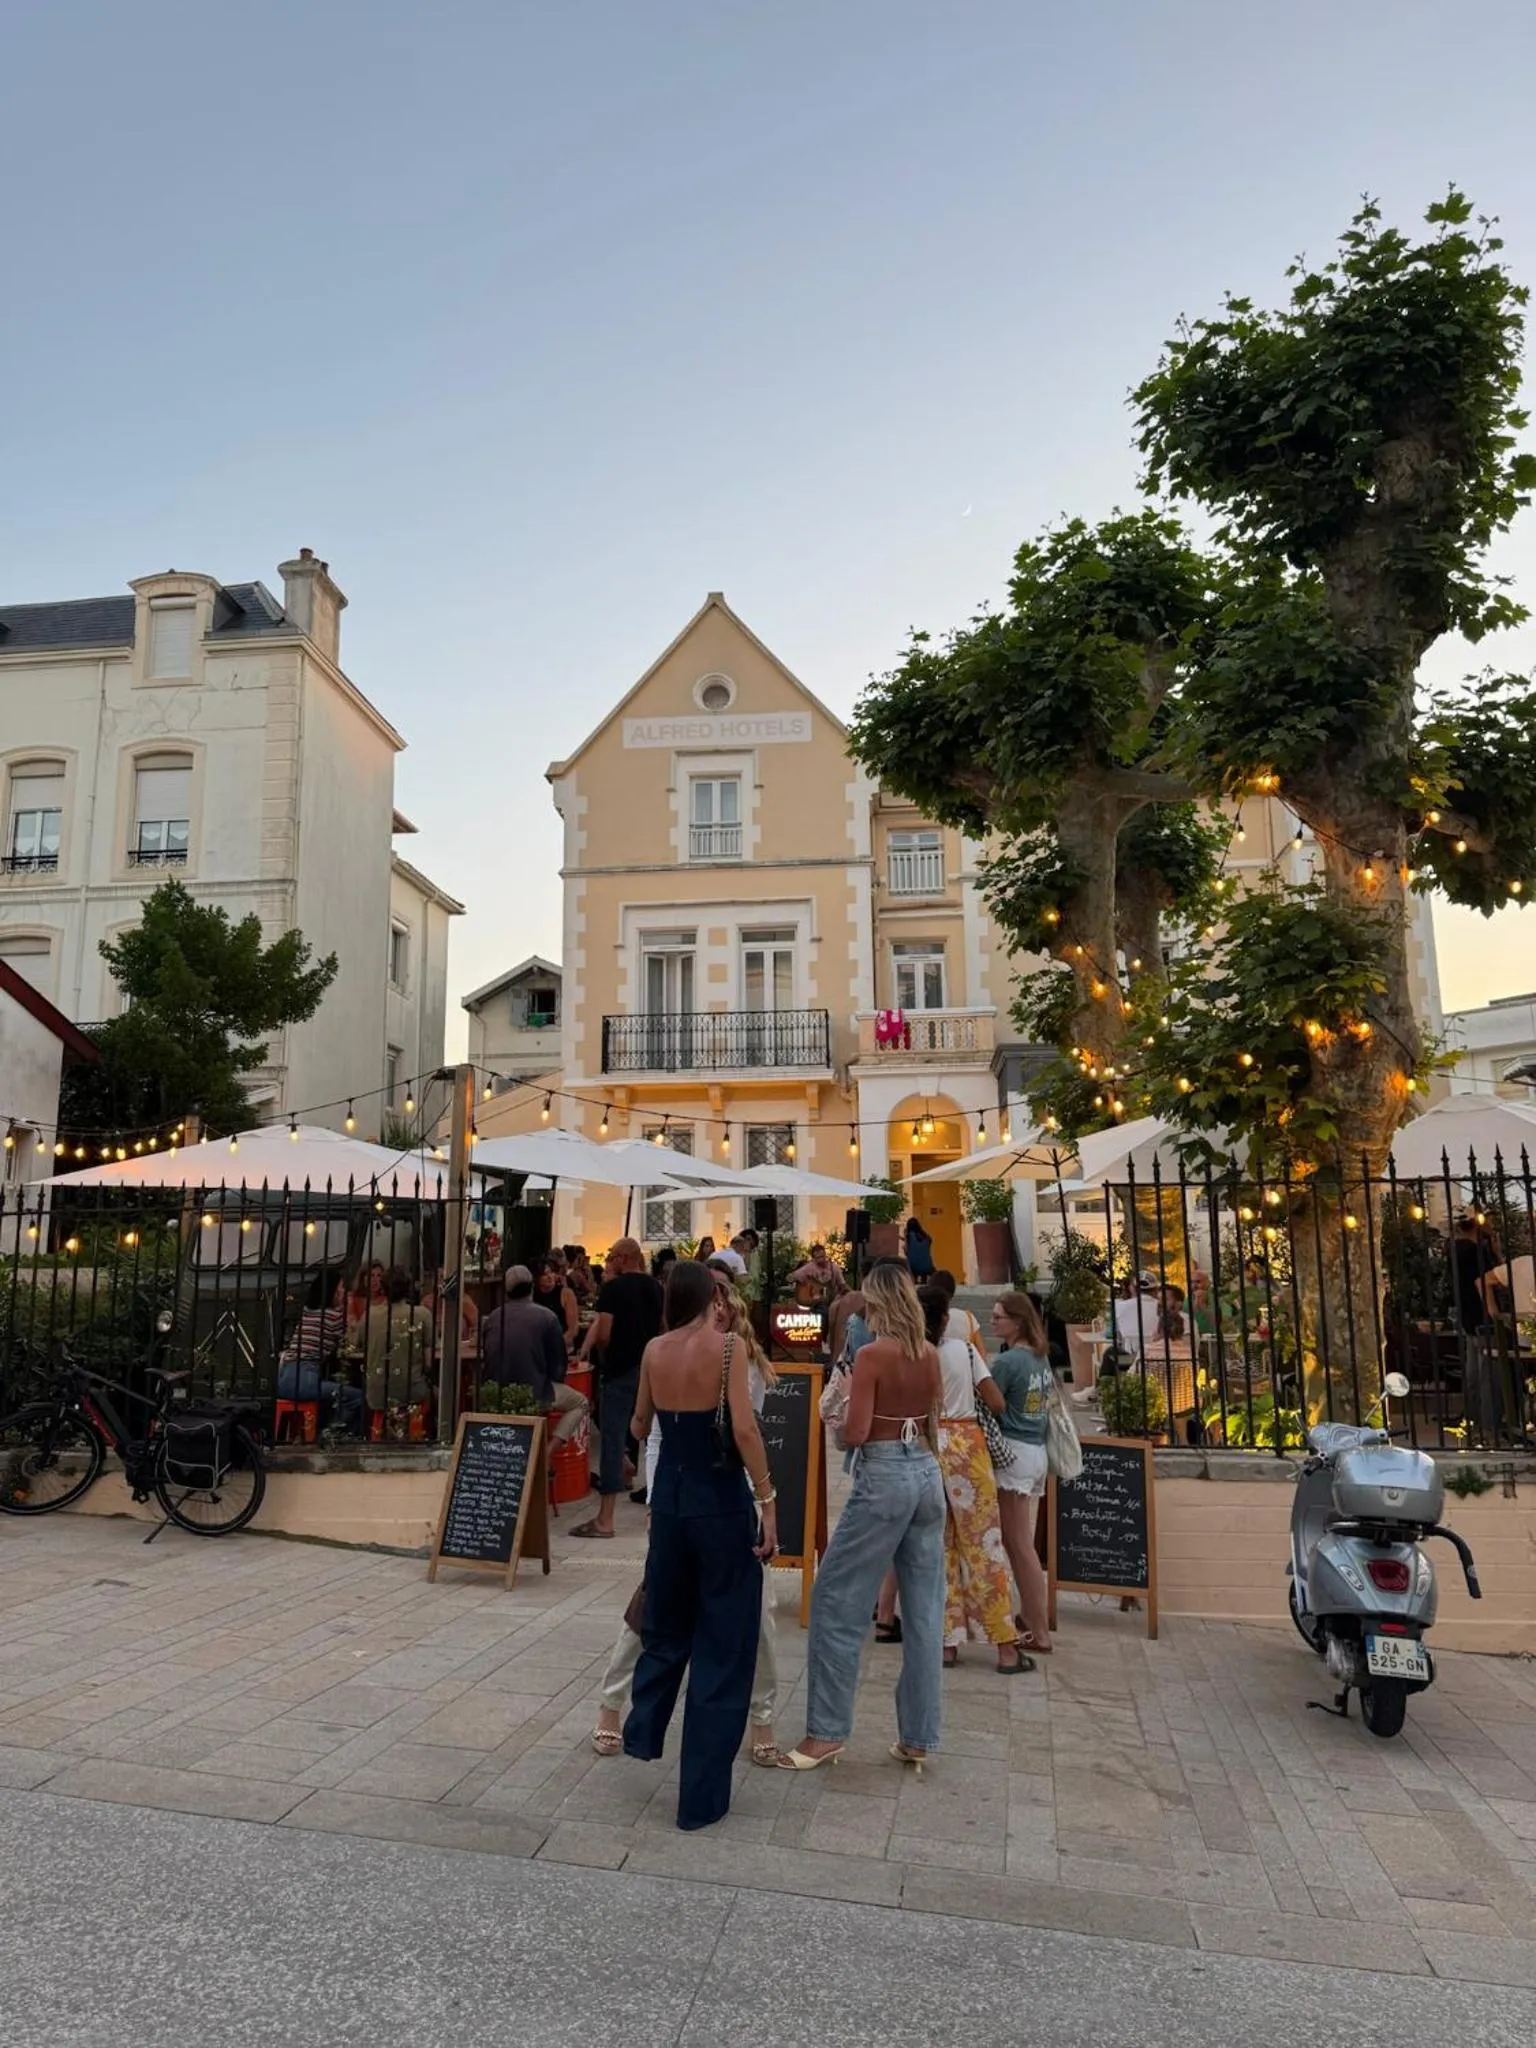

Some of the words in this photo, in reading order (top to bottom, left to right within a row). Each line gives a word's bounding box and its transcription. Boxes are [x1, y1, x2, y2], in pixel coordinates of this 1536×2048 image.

[630, 723, 713, 743] ALFRED
[719, 718, 805, 739] HOTELS
[1370, 1654, 1425, 1672] 525-GN
